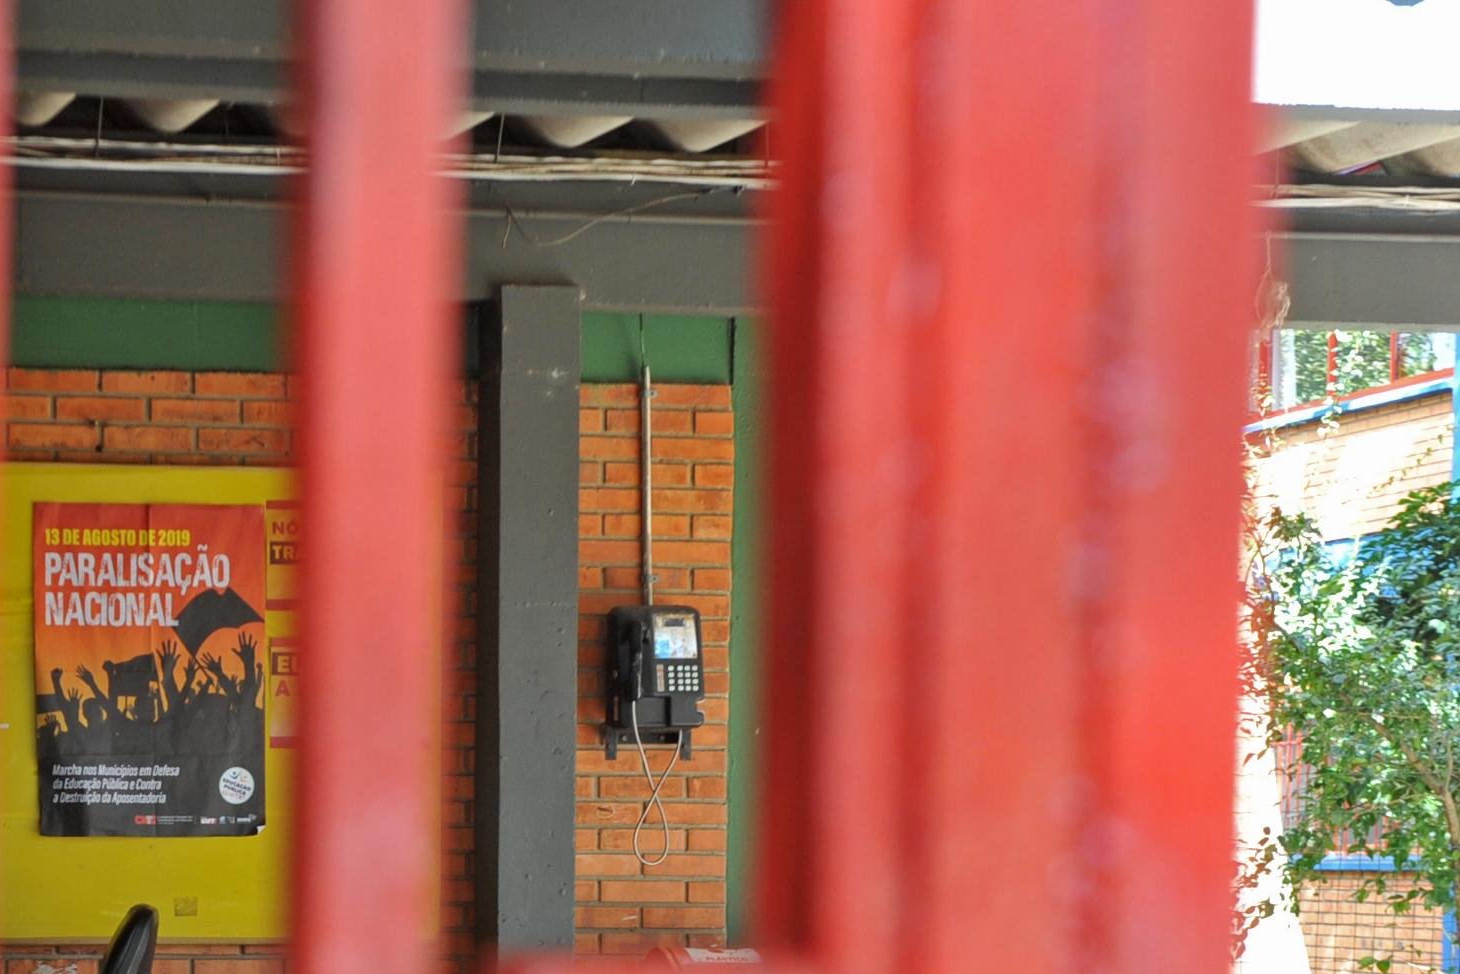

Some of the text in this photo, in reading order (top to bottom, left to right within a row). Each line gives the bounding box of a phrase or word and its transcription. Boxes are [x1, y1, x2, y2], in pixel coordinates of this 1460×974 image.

[45, 528, 191, 547] 13 DE AGOSTO DE 2019
[45, 544, 230, 596] PARALISAÇÃO
[45, 592, 179, 628] NACIONAL
[52, 763, 180, 778] Marcha nos Municípios em Defesa
[52, 777, 162, 793] da Educação Pública e Contra
[52, 791, 167, 806] a Destruição da Aposentadoria
